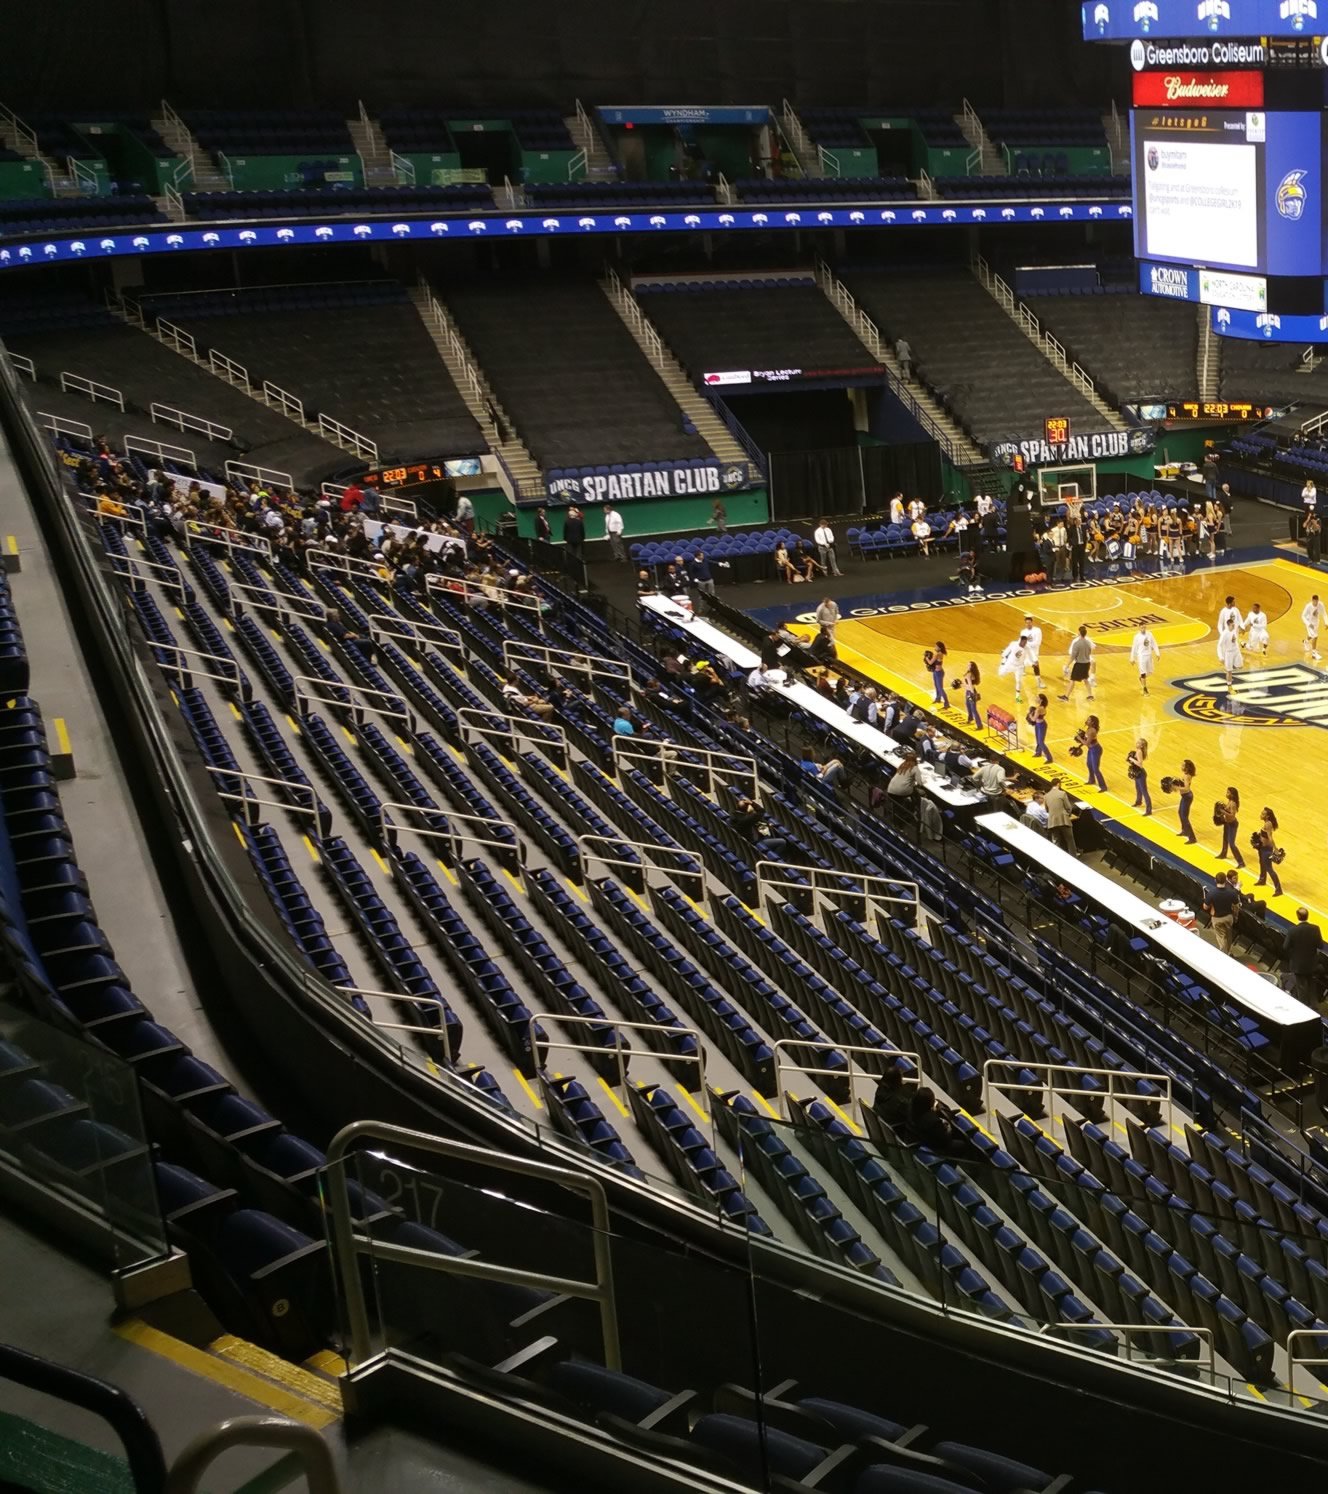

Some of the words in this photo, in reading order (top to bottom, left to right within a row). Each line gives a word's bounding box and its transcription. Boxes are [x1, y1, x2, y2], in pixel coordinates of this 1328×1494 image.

[1147, 43, 1209, 65] Greensboro
[1211, 41, 1264, 63] Coliseum
[1164, 76, 1229, 99] Budweiser
[1157, 268, 1187, 285] CROWN
[1152, 281, 1188, 298] AUTOMOTIVE
[1256, 313, 1281, 329] UNCG
[1203, 403, 1229, 414] 22:03
[1047, 420, 1067, 429] 22:03
[1091, 432, 1129, 457] CLUB
[383, 467, 407, 482] 22:03
[549, 479, 580, 495] UNCG
[582, 471, 670, 501] SPARTAN
[673, 467, 721, 495] CLUB
[849, 588, 1037, 617] Greensboro
[1046, 569, 1184, 592] Coliseum
[379, 1169, 444, 1229] 217
